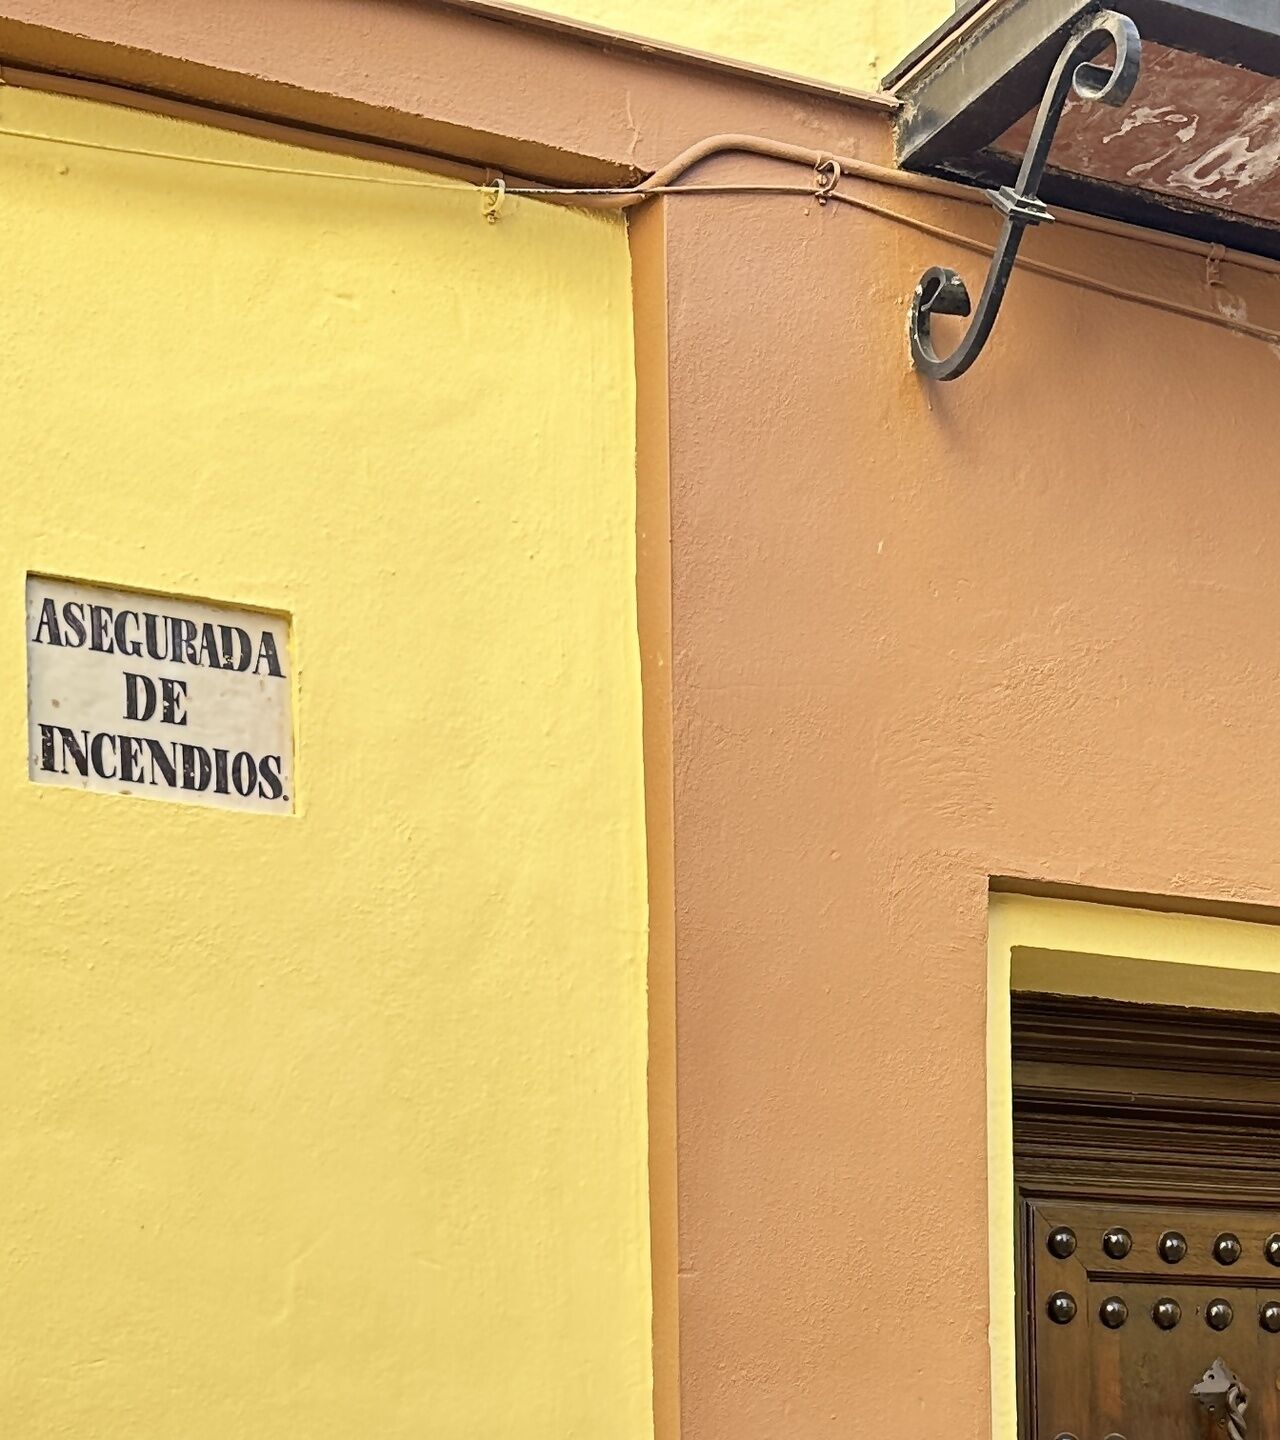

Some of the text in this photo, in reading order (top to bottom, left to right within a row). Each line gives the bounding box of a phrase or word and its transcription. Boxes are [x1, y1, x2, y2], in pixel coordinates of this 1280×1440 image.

[32, 597, 287, 678] ASEGURADA
[122, 671, 188, 726] DE
[37, 723, 290, 802] INCENDIOS.
